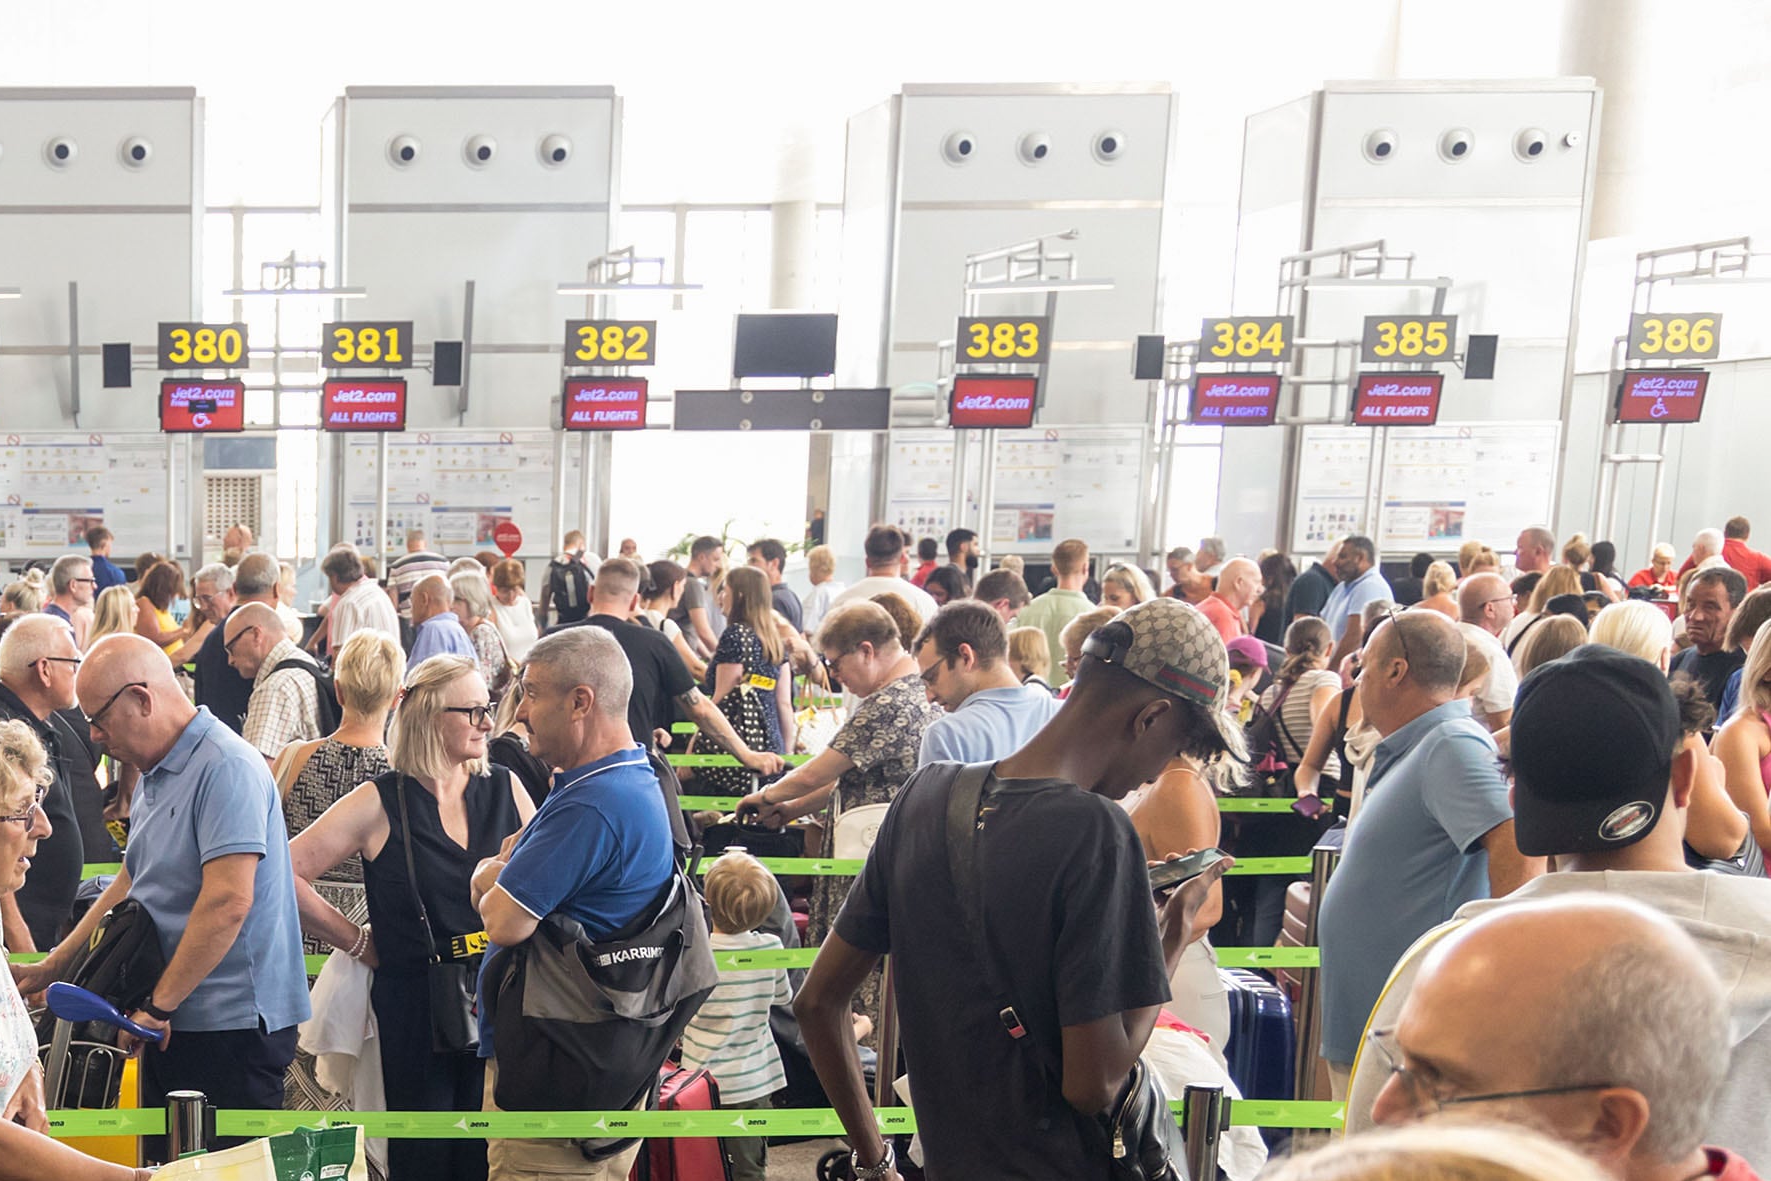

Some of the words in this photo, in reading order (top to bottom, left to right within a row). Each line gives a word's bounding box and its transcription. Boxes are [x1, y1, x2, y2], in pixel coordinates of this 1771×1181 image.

[966, 323, 1039, 358] 383
[1211, 322, 1284, 357] 384
[1373, 322, 1448, 357] 385
[1639, 319, 1715, 353] 386
[169, 328, 242, 363] 380
[332, 327, 403, 363] 381
[575, 326, 649, 361] 382
[1634, 377, 1698, 390] Jet2.com
[171, 387, 235, 400] Jet2.com
[333, 390, 397, 403] Jet2.com
[574, 389, 638, 401] Jet2.com
[1205, 384, 1270, 397] Jet2.com
[1368, 384, 1431, 397] Jet2.com
[956, 395, 1030, 409] Jet2.com
[330, 411, 350, 423] ALL
[352, 411, 397, 423] FLIGHTS
[571, 411, 591, 422] ALL
[593, 411, 638, 422] FLIGHTS
[1200, 406, 1221, 417] ALL
[1223, 406, 1268, 417] FLIGHTS
[1361, 406, 1383, 416] ALL
[1385, 406, 1429, 417] FLIGHTS
